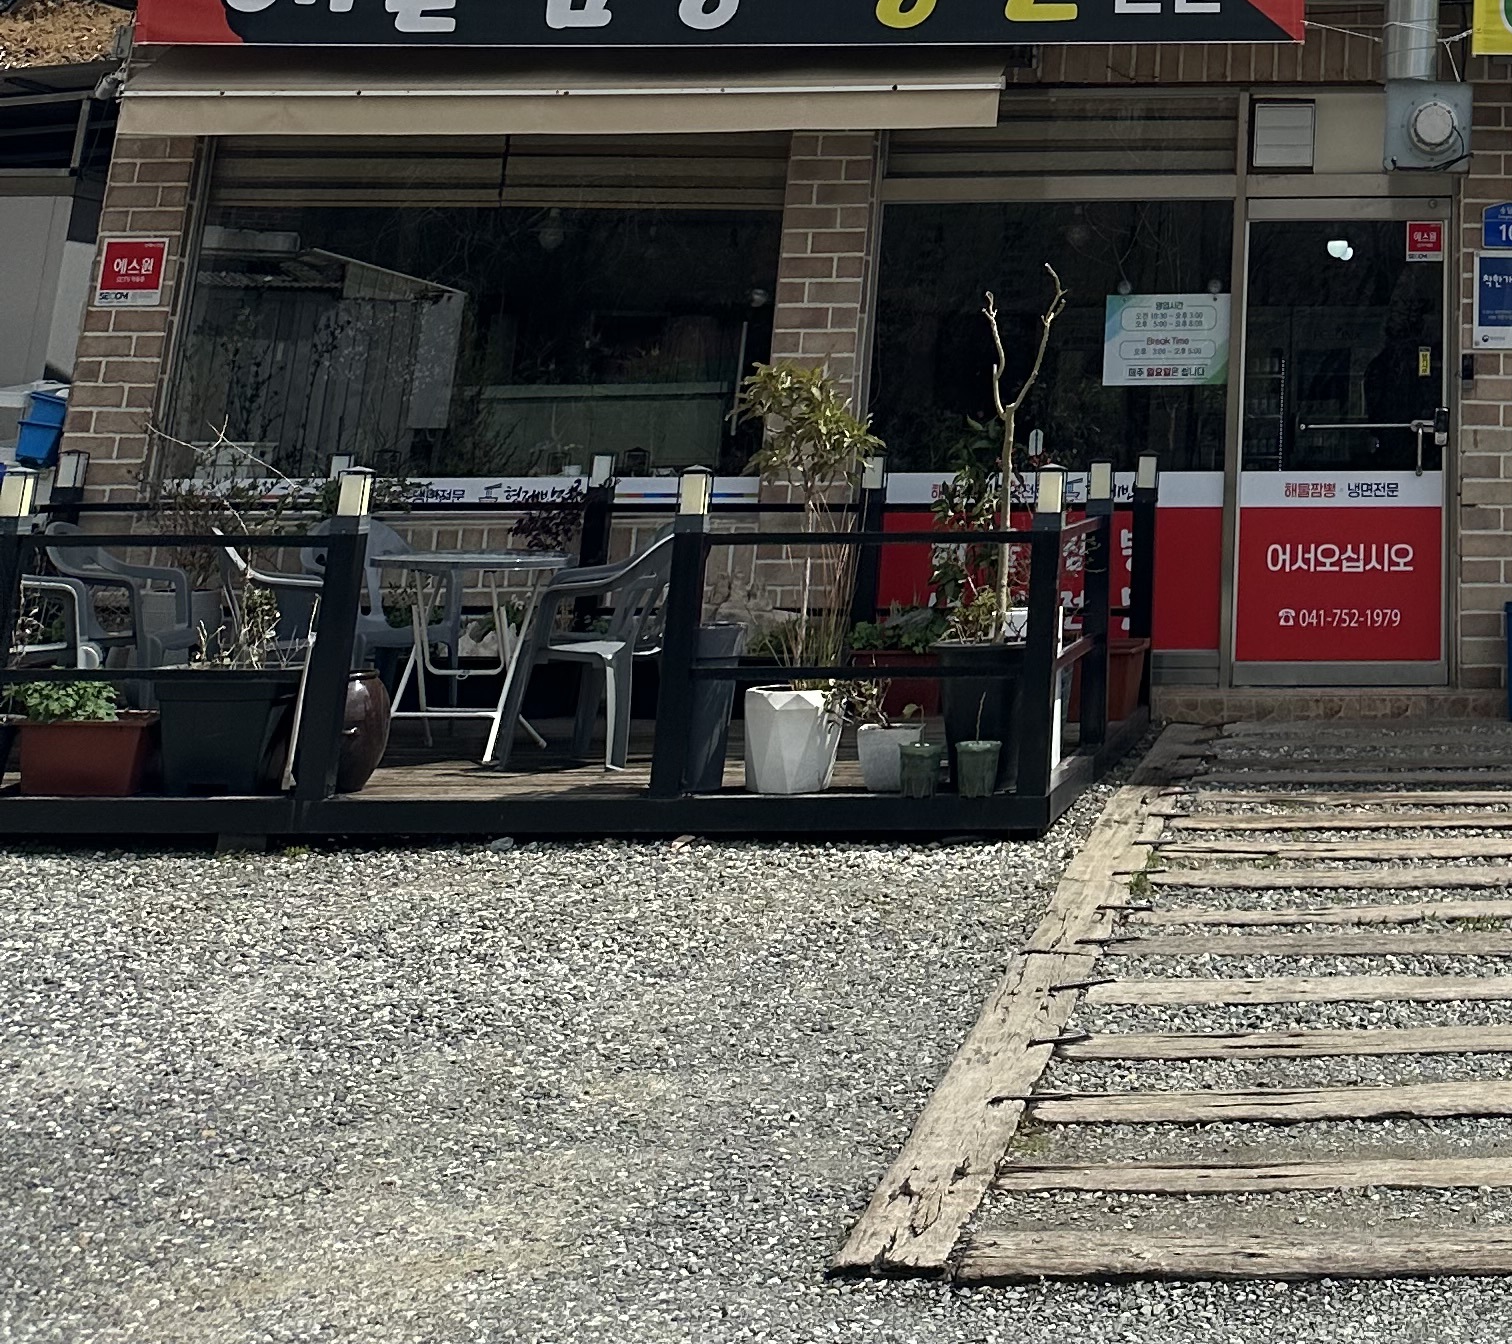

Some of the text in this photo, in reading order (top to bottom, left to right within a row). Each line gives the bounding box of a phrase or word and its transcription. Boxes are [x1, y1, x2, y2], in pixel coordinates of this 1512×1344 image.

[113, 257, 155, 275] 에스원
[1146, 336, 1190, 346] Break Time
[1284, 482, 1399, 498] 해물짬뽕 냉면전문
[1266, 543, 1415, 572] 어서오십시오
[1299, 608, 1401, 628] 041-752-1979
